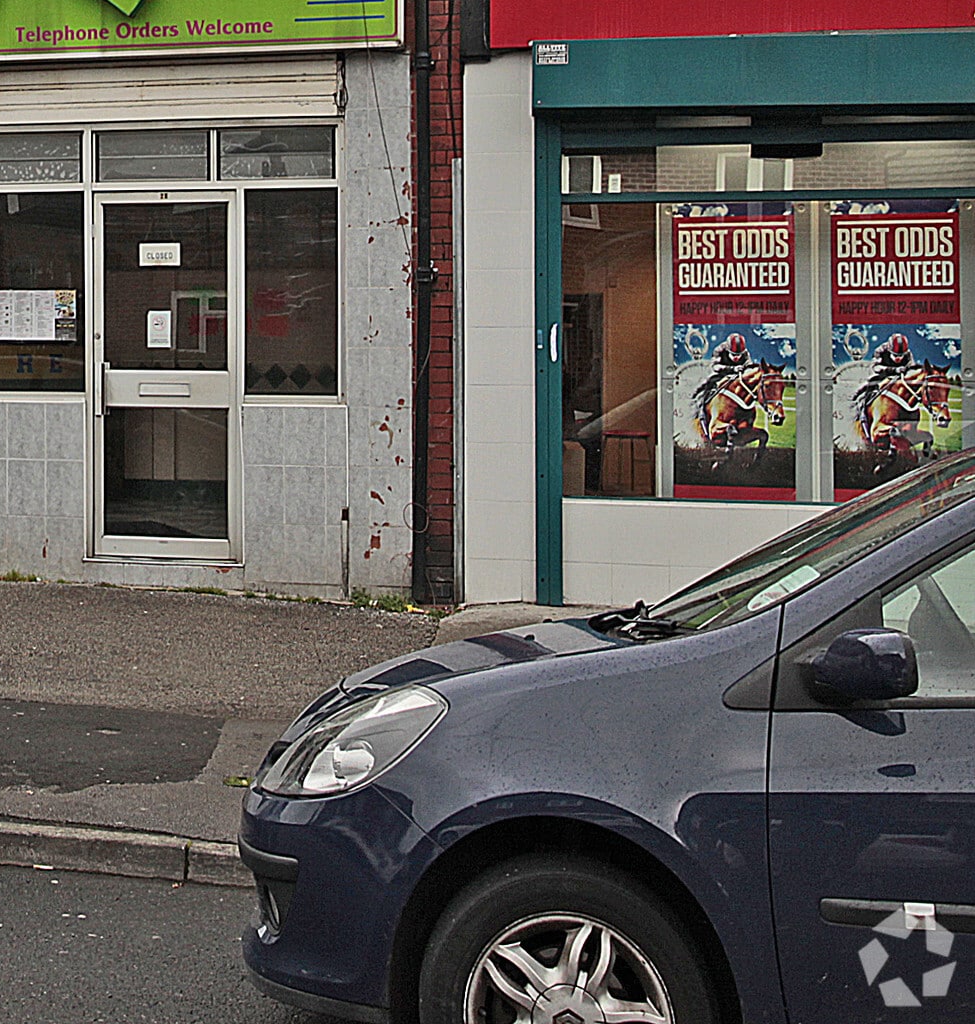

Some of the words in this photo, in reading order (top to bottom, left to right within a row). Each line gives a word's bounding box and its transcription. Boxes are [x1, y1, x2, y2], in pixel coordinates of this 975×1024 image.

[15, 25, 110, 46] Telephone
[115, 22, 179, 39] Orders
[186, 19, 274, 37] Welcome
[678, 229, 729, 260] BEST
[732, 228, 789, 259] ODDS
[836, 227, 890, 258] BEST
[894, 226, 954, 257] ODDS
[146, 252, 174, 260] CLOSED
[678, 262, 790, 288] GUARANTEED
[837, 261, 954, 287] GUARANTEED
[839, 302, 869, 314] HAPPY
